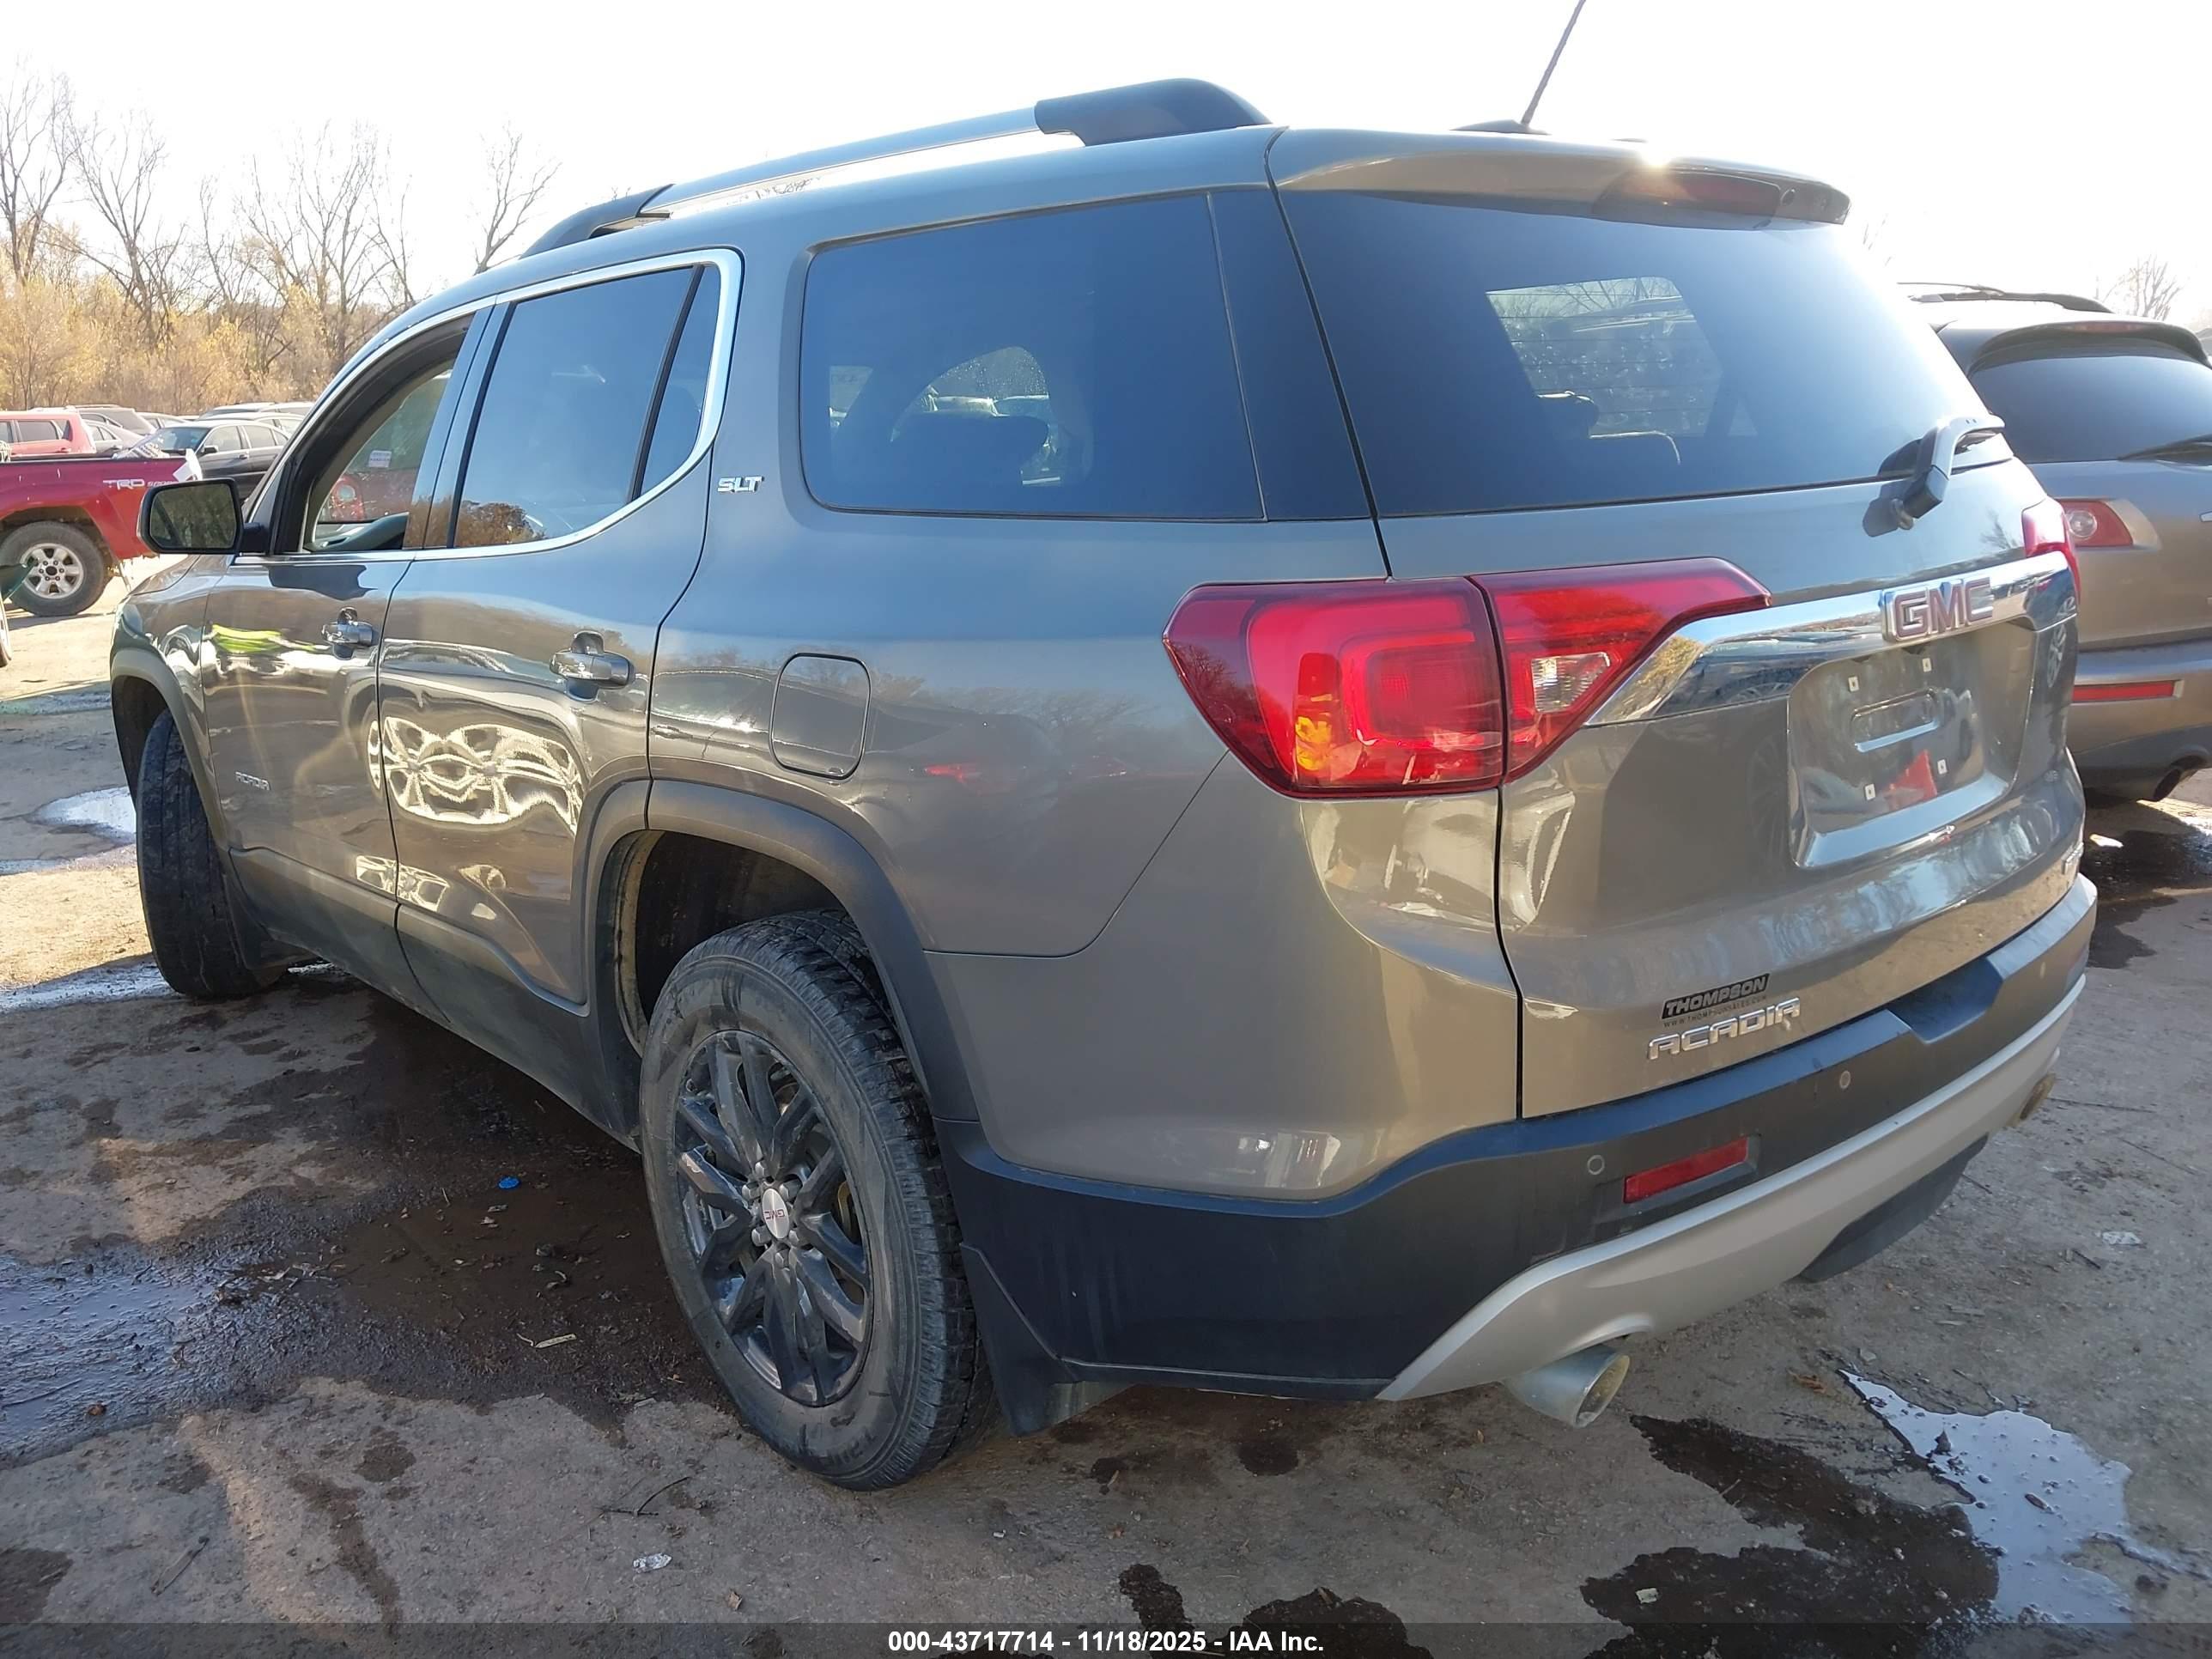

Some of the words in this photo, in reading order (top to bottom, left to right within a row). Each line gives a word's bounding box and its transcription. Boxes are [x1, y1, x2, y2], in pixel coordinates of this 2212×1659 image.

[102, 478, 145, 490] TRD
[718, 476, 764, 493] SLT
[1892, 576, 1994, 641] GMC
[1665, 975, 1768, 1018] THOMPSON
[1648, 997, 1801, 1060] ACADIA
[764, 1208, 786, 1219] GMC
